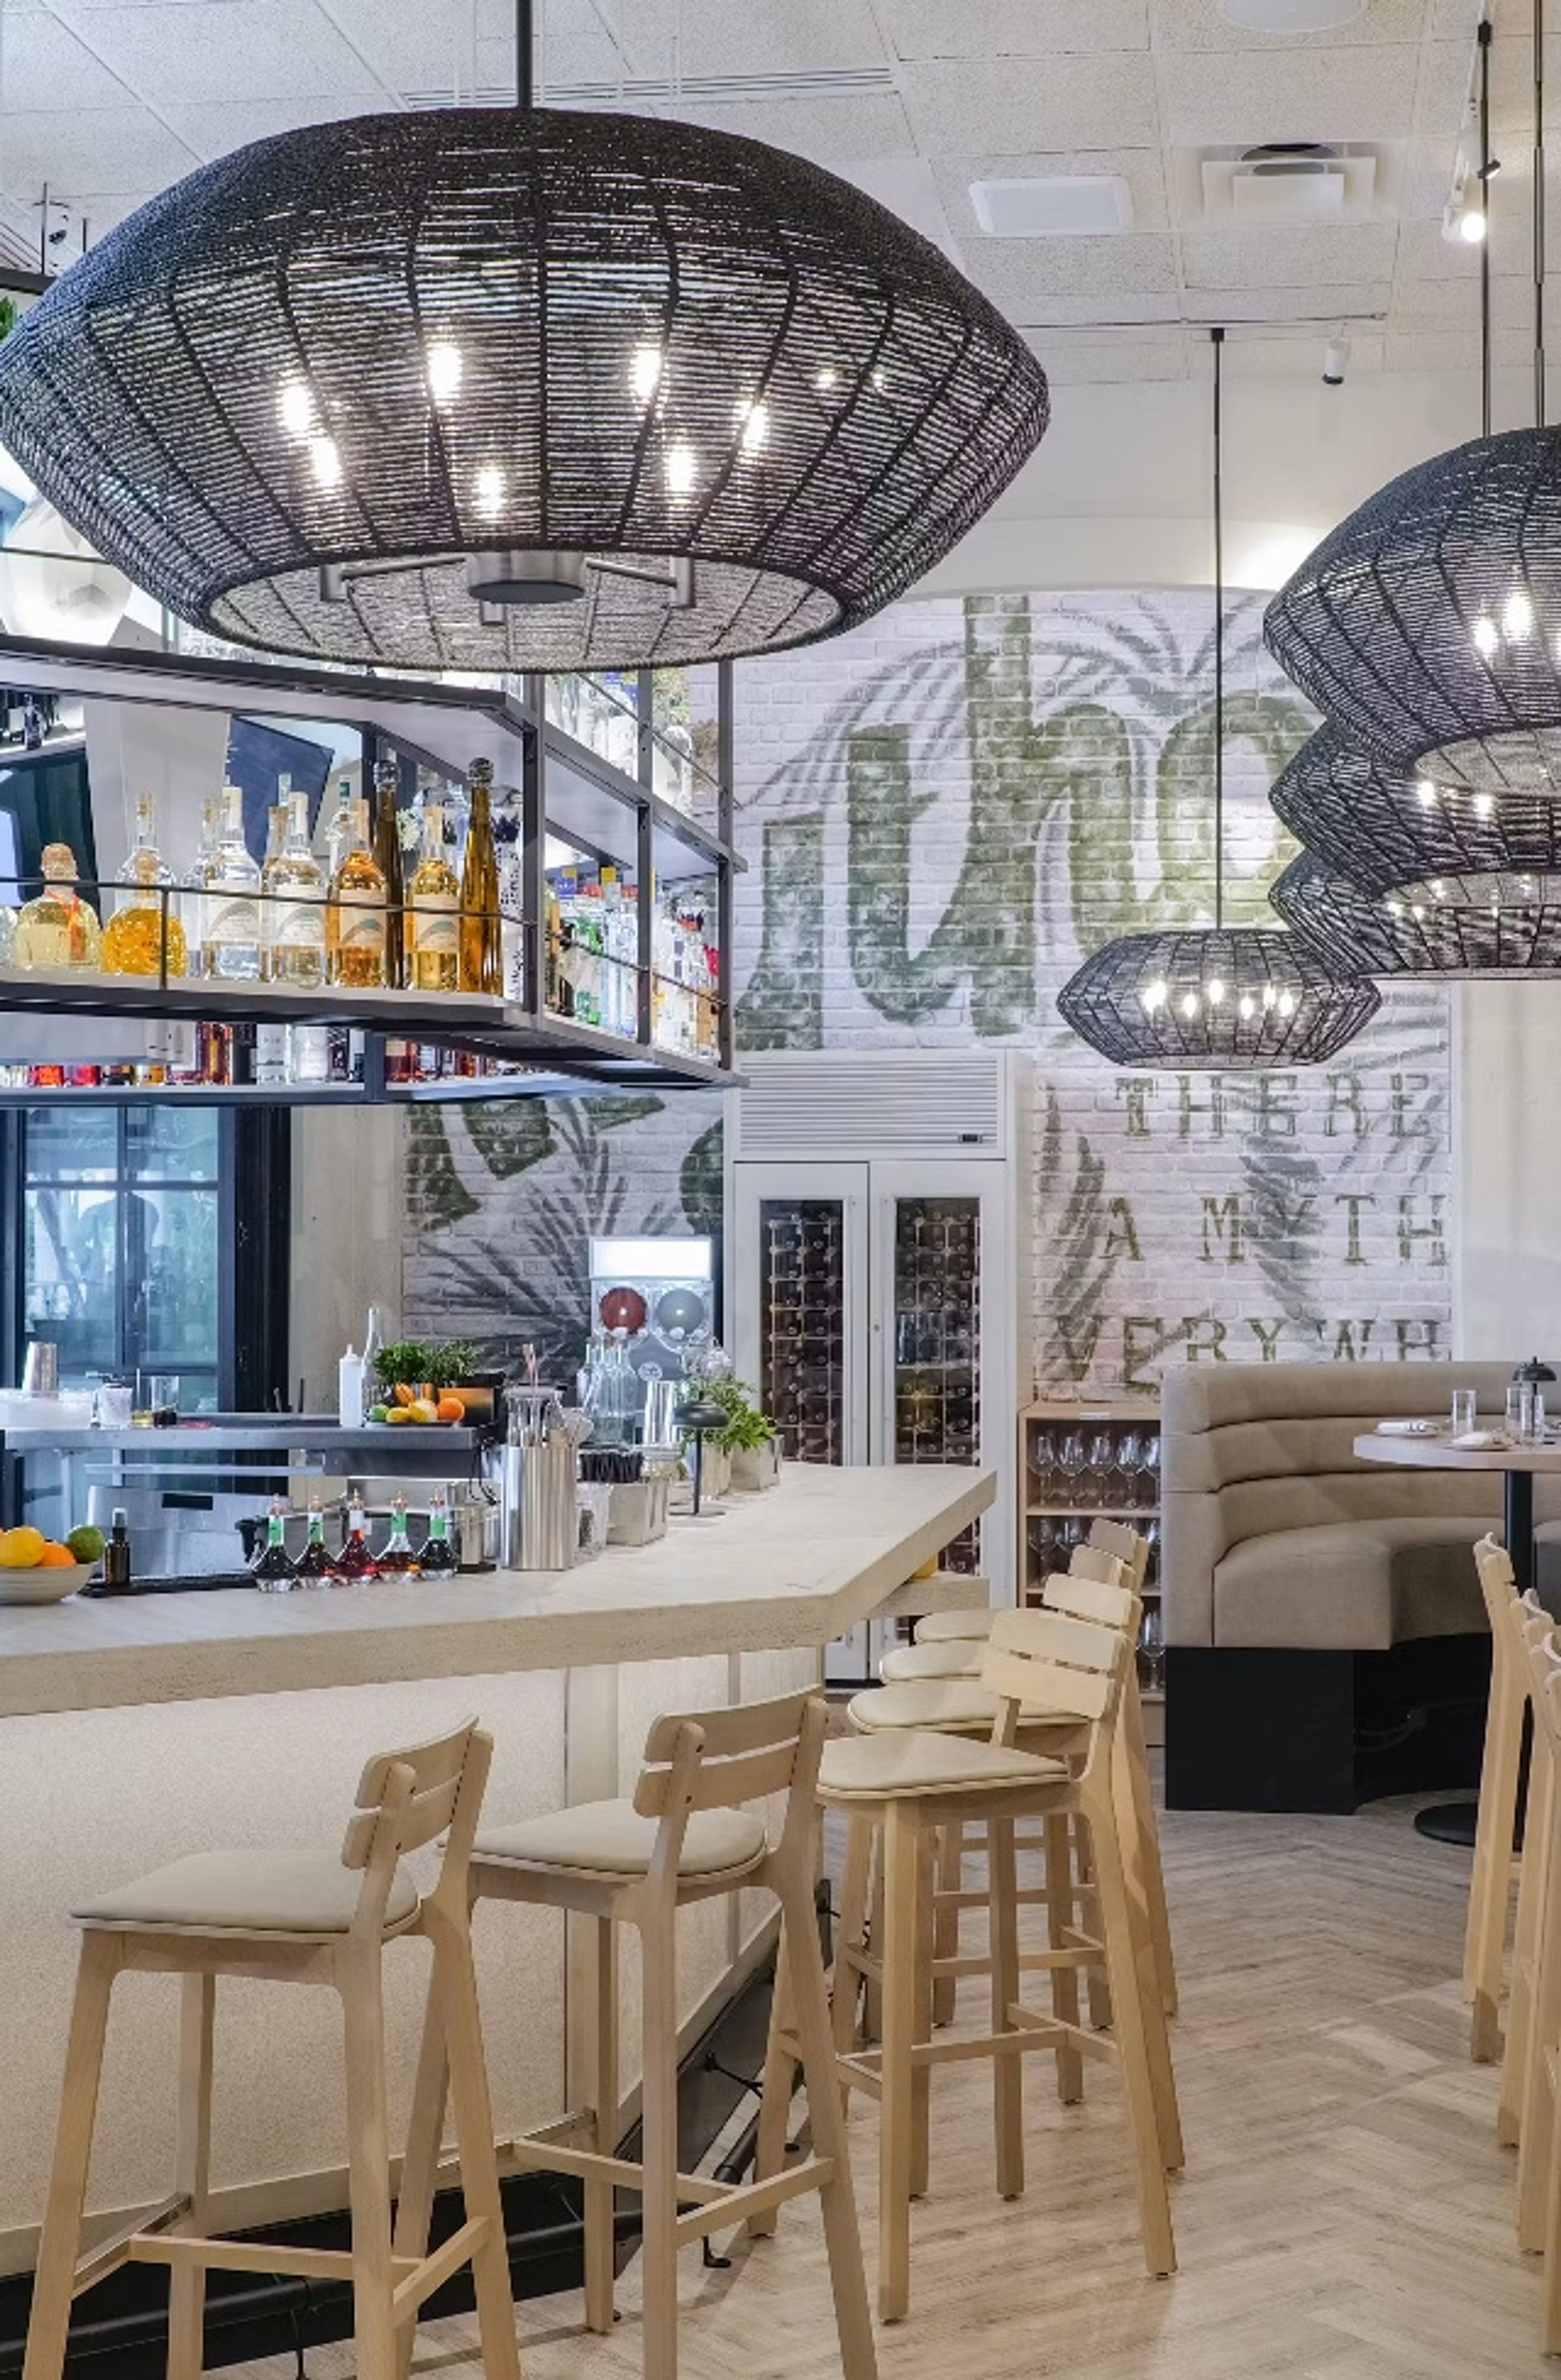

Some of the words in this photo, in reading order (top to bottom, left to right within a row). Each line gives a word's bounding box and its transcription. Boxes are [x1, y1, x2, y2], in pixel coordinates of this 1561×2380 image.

[1114, 1073, 1432, 1140] THERE
[1098, 1197, 1146, 1261] A
[1196, 1192, 1448, 1266] MYTH
